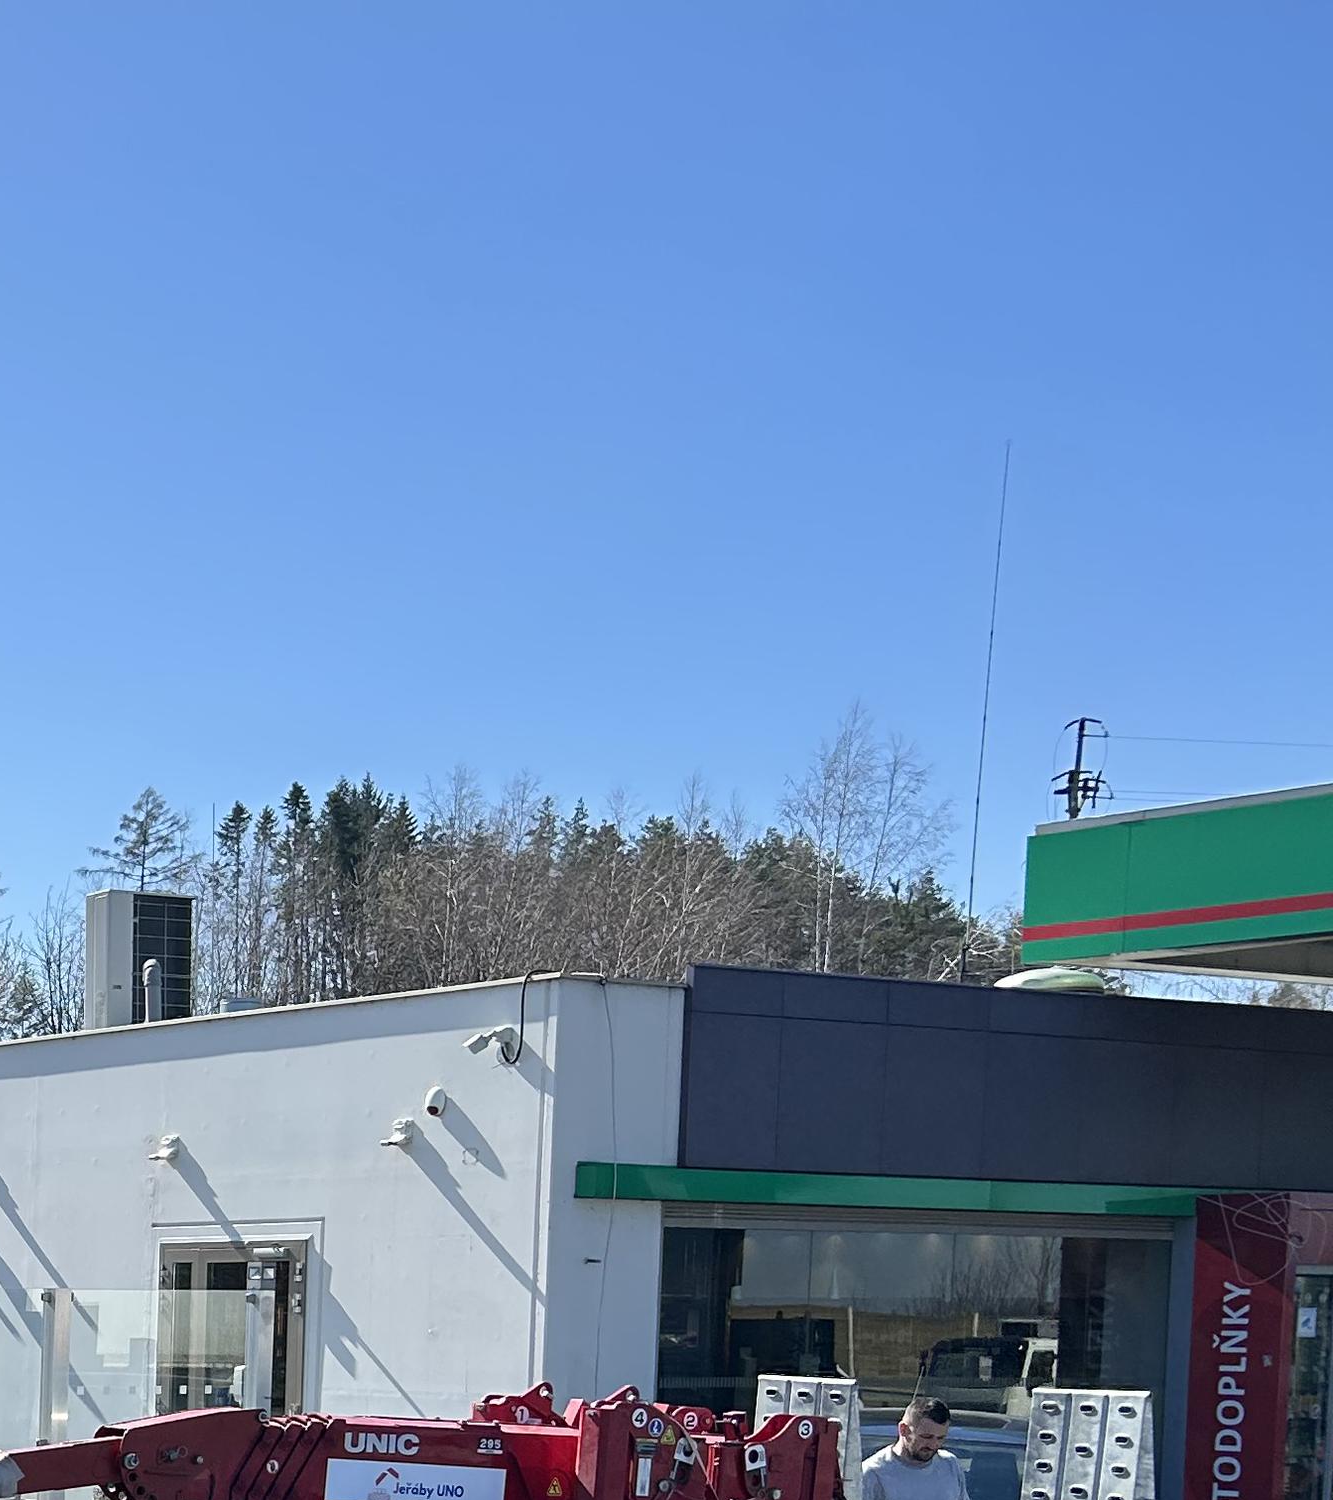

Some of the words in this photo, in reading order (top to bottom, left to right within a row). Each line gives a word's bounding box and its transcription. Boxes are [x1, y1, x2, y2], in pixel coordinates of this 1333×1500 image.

[634, 1411, 645, 1425] 4
[686, 1415, 696, 1427] 2
[800, 1423, 810, 1436] 3
[344, 1432, 420, 1455] UNIC
[479, 1438, 502, 1449] 295
[393, 1482, 434, 1499] Jeřáby
[437, 1484, 464, 1498] UNO
